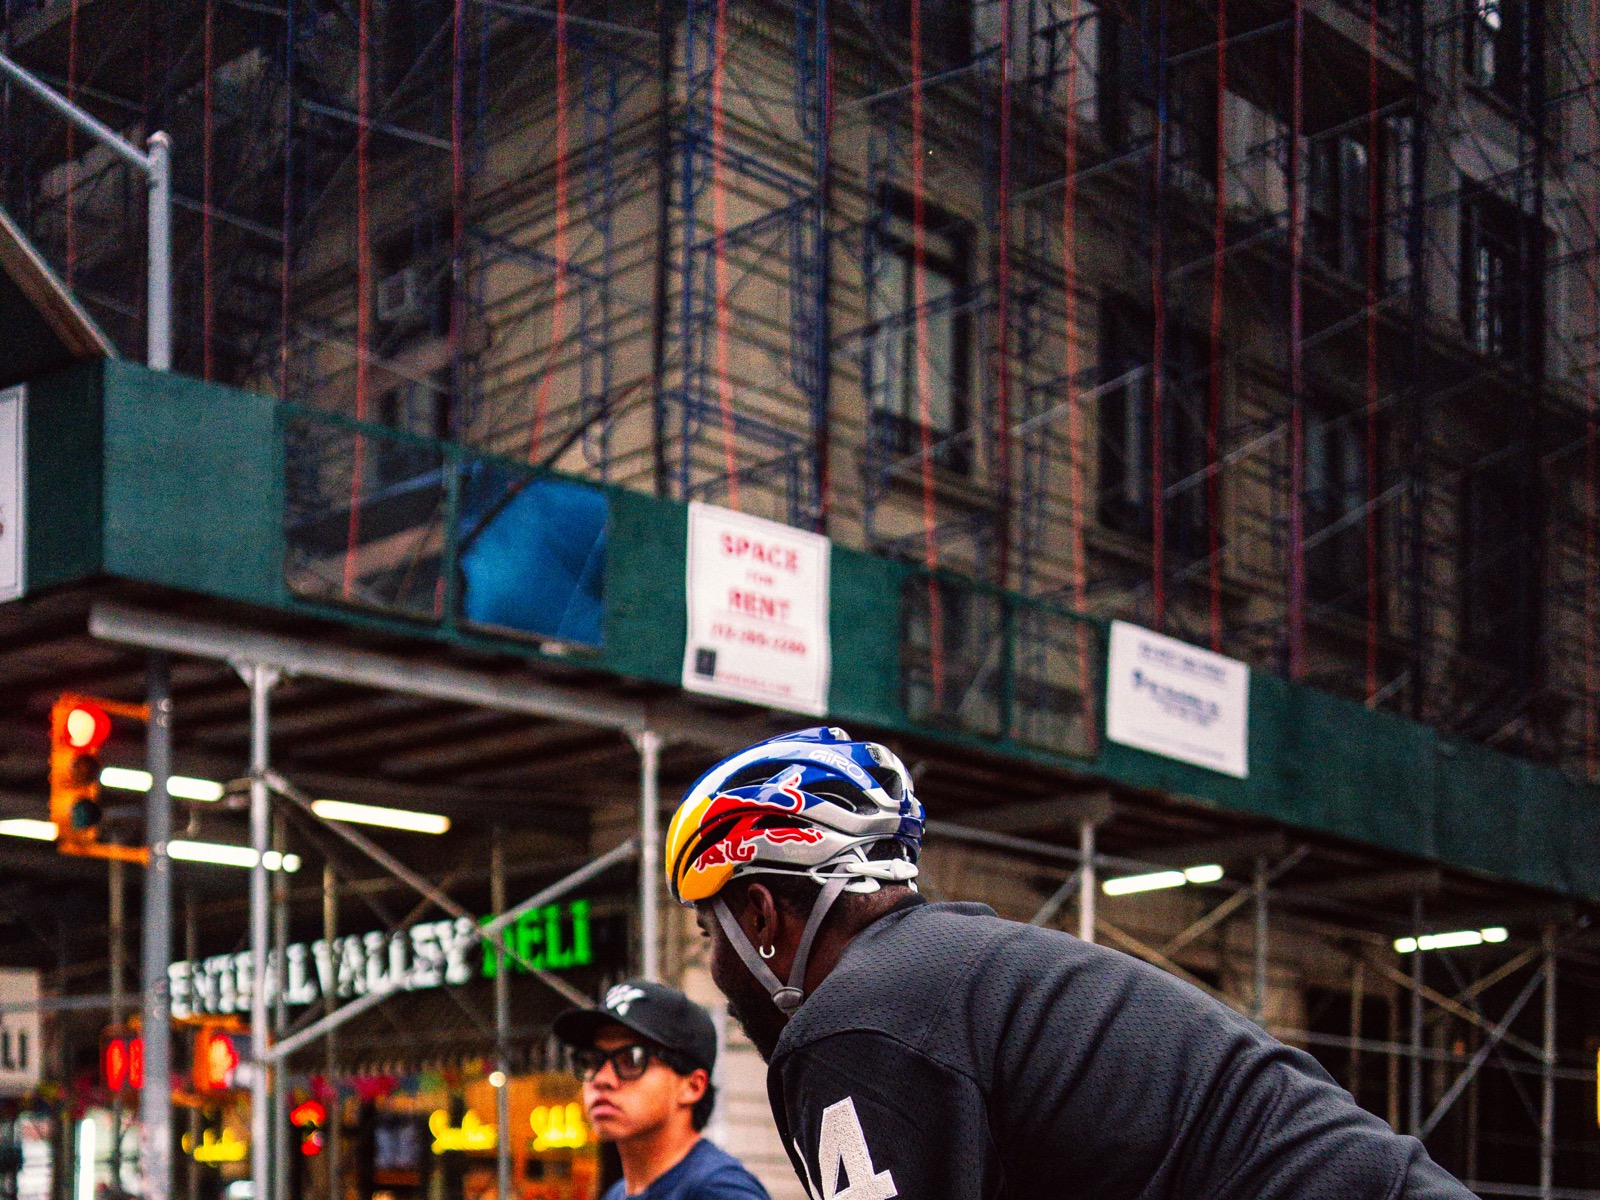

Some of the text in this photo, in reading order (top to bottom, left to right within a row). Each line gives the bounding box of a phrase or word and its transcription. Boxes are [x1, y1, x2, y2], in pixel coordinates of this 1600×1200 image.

[721, 531, 798, 573] SPACE
[728, 586, 790, 620] RENT
[808, 749, 865, 780] GIRO
[311, 916, 472, 998] VALLEY
